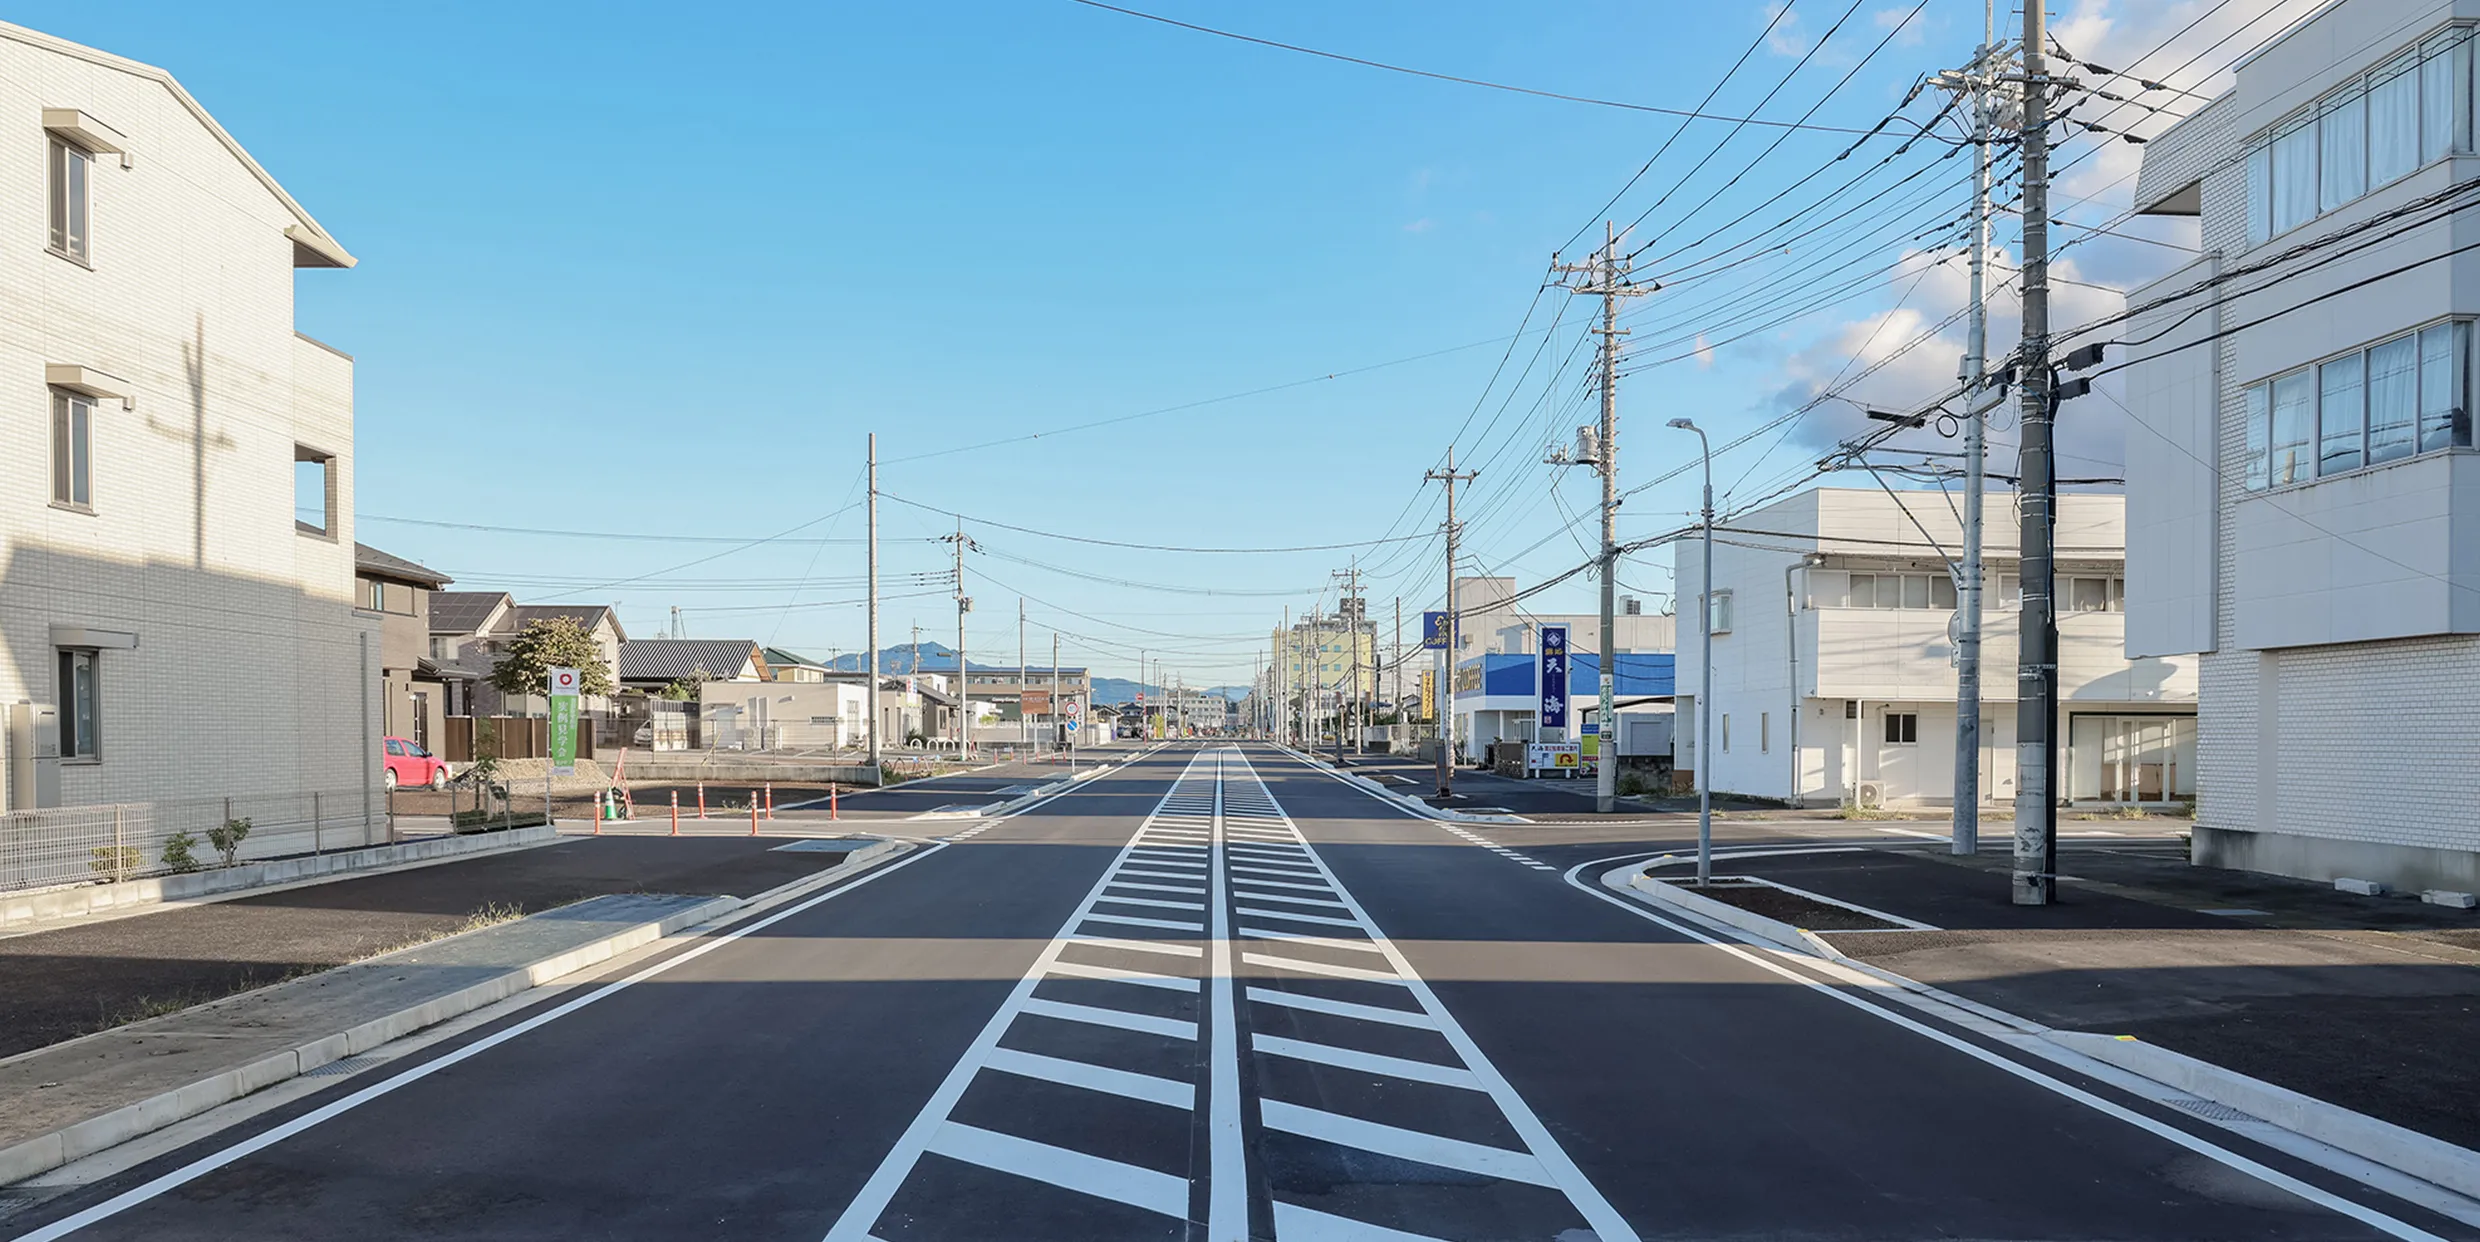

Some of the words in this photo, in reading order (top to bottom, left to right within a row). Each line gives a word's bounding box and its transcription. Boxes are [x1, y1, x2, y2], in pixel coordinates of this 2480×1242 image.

[557, 701, 568, 757] 実例見学会
